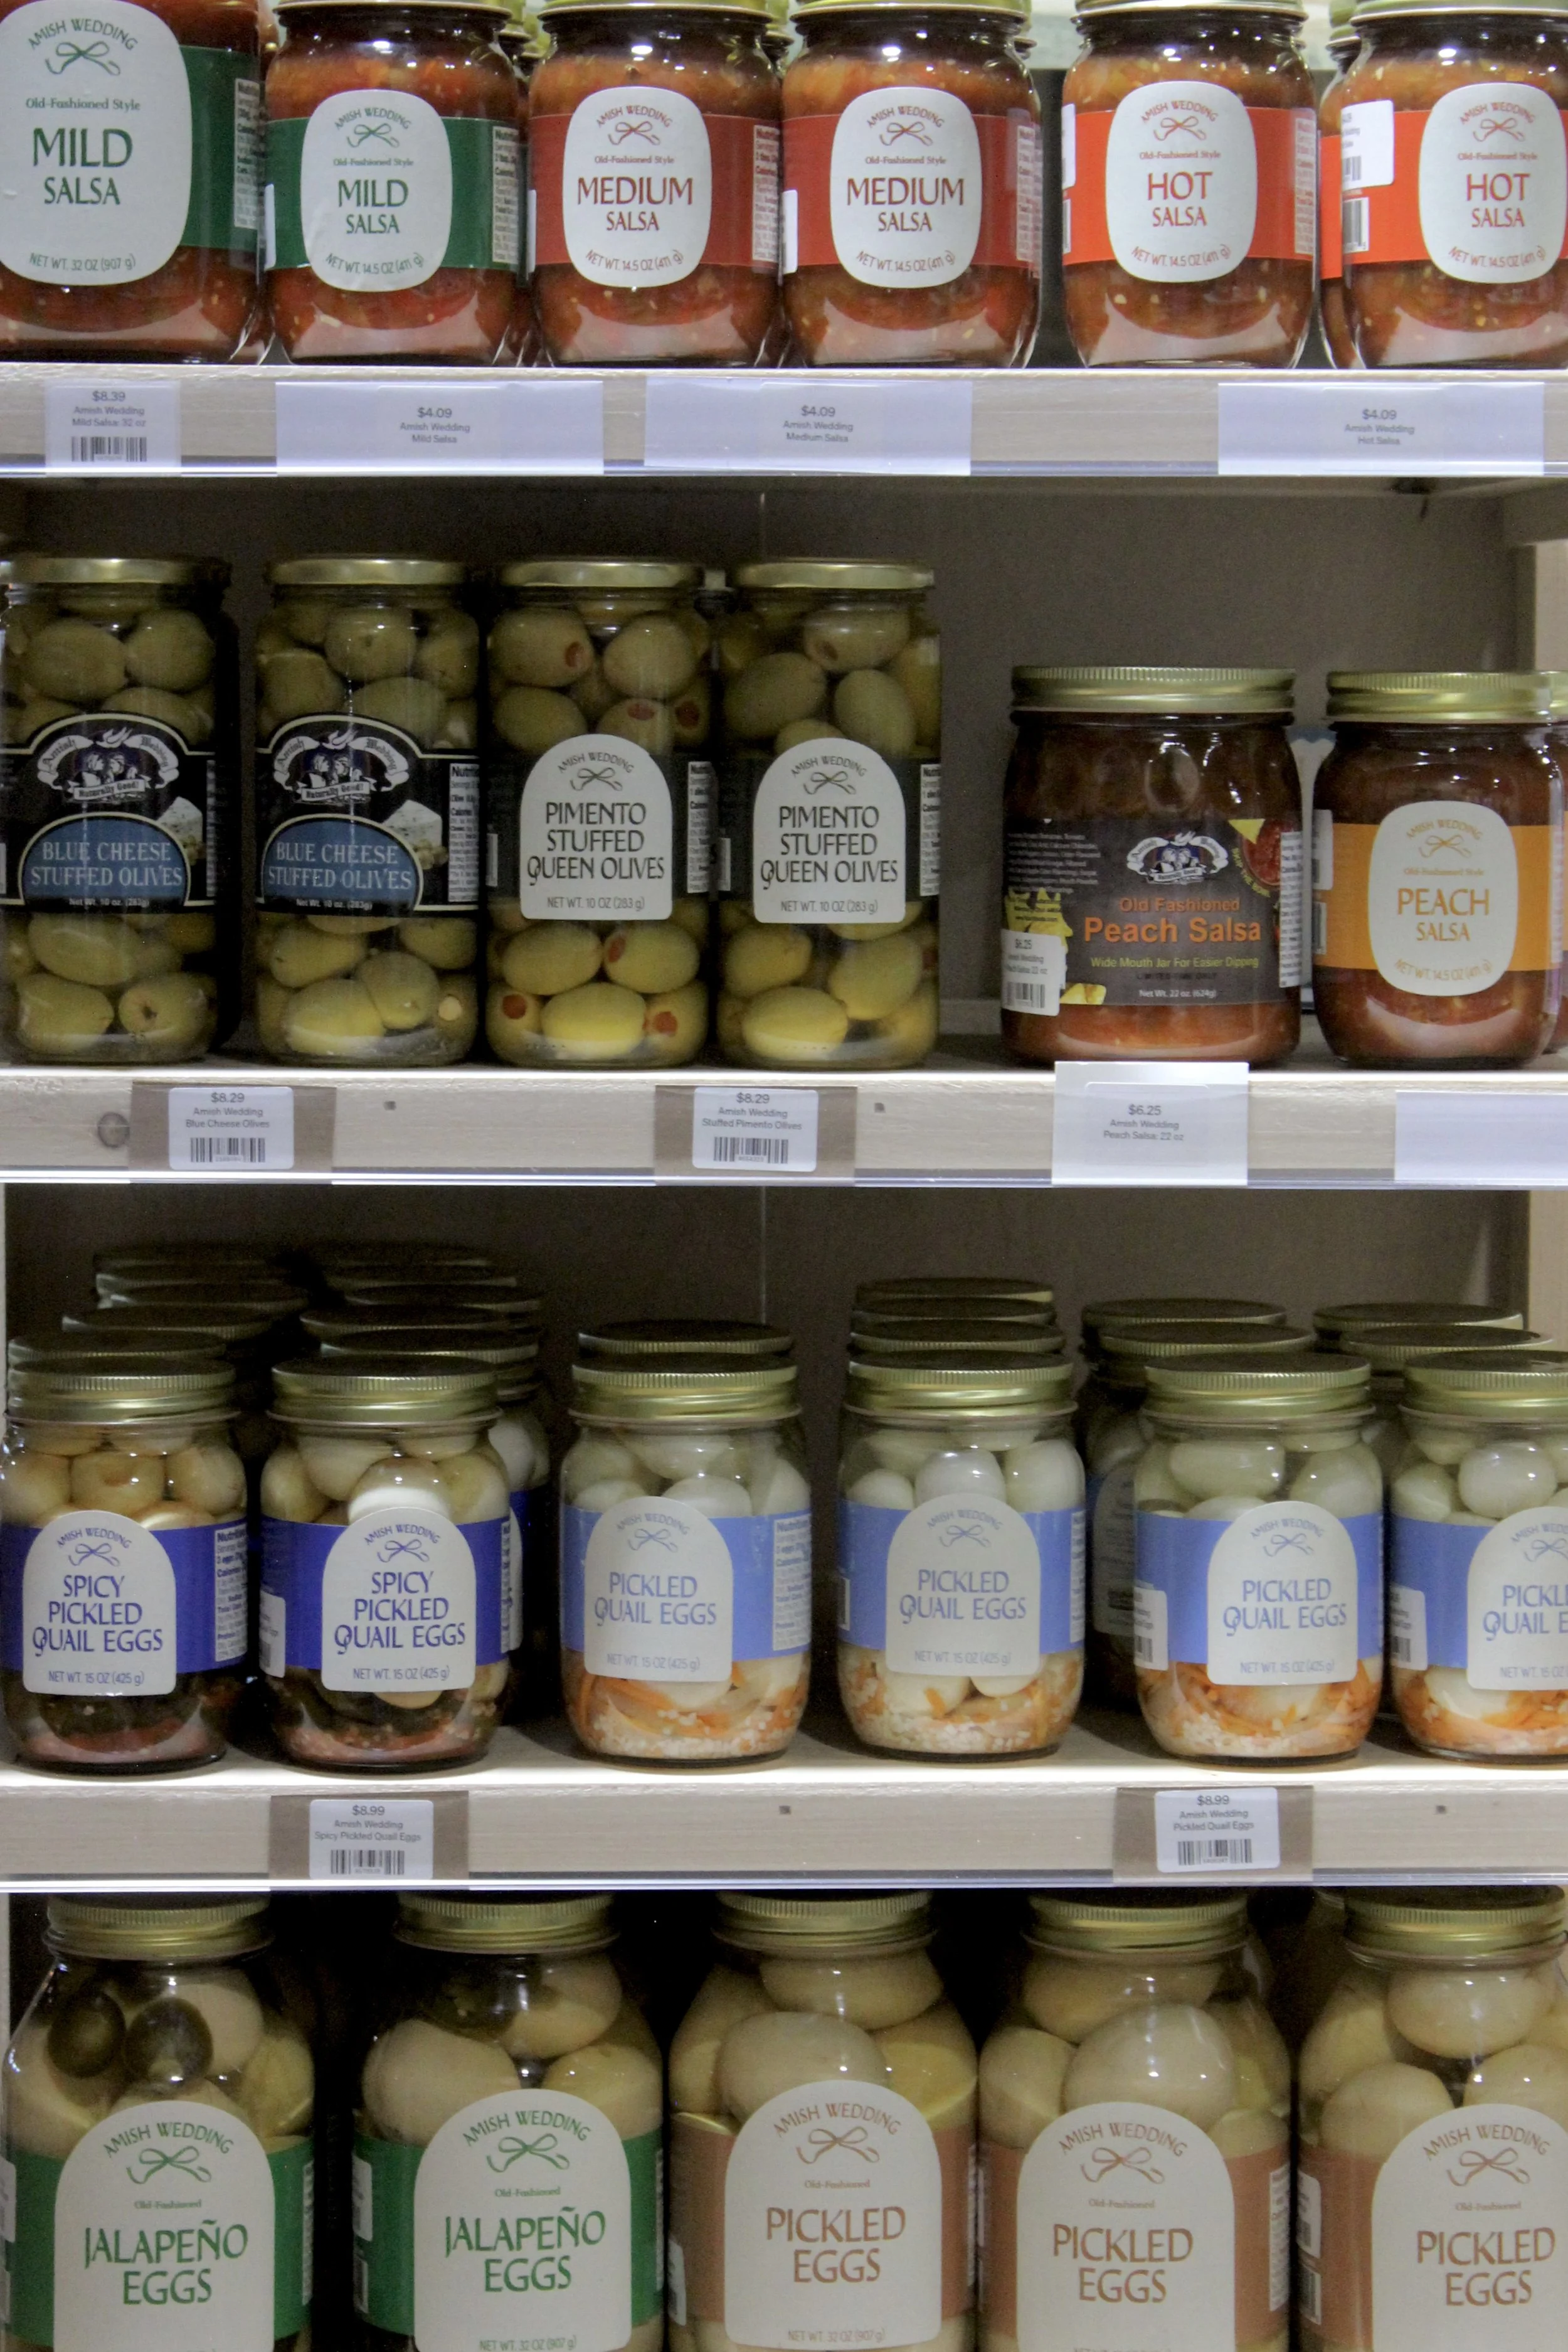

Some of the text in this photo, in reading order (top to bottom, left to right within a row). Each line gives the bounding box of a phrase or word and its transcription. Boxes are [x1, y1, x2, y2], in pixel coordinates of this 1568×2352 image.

[28, 18, 137, 51] AMISH WEDDING
[26, 97, 140, 111] Old-Fashioned Style
[334, 107, 411, 129] AMISH WEDDING
[596, 105, 672, 127] AMISH WEDDING
[33, 129, 132, 168] MILD
[1139, 151, 1221, 161] Old-Fashioned Style
[44, 177, 120, 205] SALSA
[338, 179, 408, 208] MILD
[578, 177, 692, 206] MEDIUM
[847, 178, 964, 206] MEDIUM
[1147, 172, 1213, 201] HOT
[1466, 174, 1530, 202] HOT
[346, 214, 400, 233] SALSA
[606, 211, 659, 231] SALSA
[878, 212, 932, 232] SALSA
[1153, 207, 1207, 227] SALSA
[1471, 208, 1525, 228] SALSA
[29, 253, 135, 272] NET WT. 32 OZ (907 g)
[92, 391, 125, 402] $8.39
[74, 407, 144, 416] Amish Wedding
[418, 408, 452, 418] $4.09
[802, 406, 835, 417] $4.09
[1362, 409, 1397, 420] $4.09
[400, 423, 470, 432] Amish Wedding
[783, 421, 853, 432] Amish Wedding
[787, 432, 848, 442] Medium Salsa
[1345, 424, 1414, 435] Amish Wedding
[434, 435, 457, 443] Salsa
[558, 752, 635, 774] AMISH WEDDING
[545, 802, 647, 826] PIMENTO
[778, 806, 880, 829] PIMENTO
[42, 843, 171, 860] BLUE CHEESE
[546, 830, 644, 853] STUFFED
[780, 833, 877, 856] STUFFED
[276, 843, 398, 864] BLUE CHEESE
[31, 867, 183, 886] STUFFED OLIVES
[269, 866, 411, 890] STUFFED OLIVES
[527, 856, 665, 885] QUEEN OLIVES
[760, 859, 898, 890] QUEEN OLIVES
[547, 897, 645, 912] NET WT. 10 OZ (283 g)
[1119, 898, 1239, 912] Old Fashioned
[1397, 888, 1490, 916] PEACH
[1084, 917, 1261, 942] Peach Salsa
[1416, 922, 1471, 941] SALSA
[1091, 957, 1259, 968] Wide Mouth Jar For Easier Dipping
[211, 1092, 245, 1103] $8.29
[736, 1093, 770, 1104] $8.29
[225, 1108, 263, 1117] Wedding
[718, 1107, 788, 1118] Amish Wedding
[1129, 1104, 1161, 1115] $6.25
[208, 1120, 240, 1128] Cheese
[243, 1120, 270, 1128] Olives
[702, 1118, 802, 1130] Stuffed Pimento Olives
[1140, 1120, 1179, 1130] Wedding
[63, 1575, 125, 1598] SPICY
[371, 1572, 433, 1594] SPICY
[609, 1572, 697, 1597] PICKLED
[918, 1569, 1010, 1593] PICKLED
[1242, 1578, 1332, 1602] PICKLED
[48, 1602, 142, 1624] PICKLED
[354, 1598, 449, 1621] PICKLED
[594, 1597, 716, 1627] QUAIL EGGS
[900, 1594, 1027, 1624] QUAIL EGGS
[1223, 1604, 1347, 1637] QUAIL EGGS
[33, 1626, 163, 1657] QUAIL EGGS
[334, 1623, 465, 1654] QUAIL EGGS
[352, 1805, 384, 1816] $8.99
[1197, 1795, 1229, 1806] $8.99
[364, 1820, 403, 1830] Wedding
[1207, 1823, 1230, 1831] Quail
[1233, 1821, 1254, 1831] Eggs
[1210, 1811, 1248, 1819] Wedding
[315, 1831, 421, 1843] Spicy Pickled Quail Eggs
[773, 2102, 902, 2137] AMISH WEDDING
[103, 2122, 234, 2158] AMISH WEDDING
[445, 2206, 606, 2259] JALAPEÑO
[766, 2206, 906, 2243] PICKLED
[85, 2218, 249, 2270] JALAPEÑO
[1053, 2223, 1193, 2262] PICKLED
[1417, 2227, 1555, 2266] PICKLED
[484, 2255, 571, 2292] EGGS
[793, 2249, 880, 2284] EGGS
[123, 2269, 212, 2304] EGGS
[1079, 2269, 1166, 2304] EGGS
[1444, 2272, 1532, 2306] EGGS
